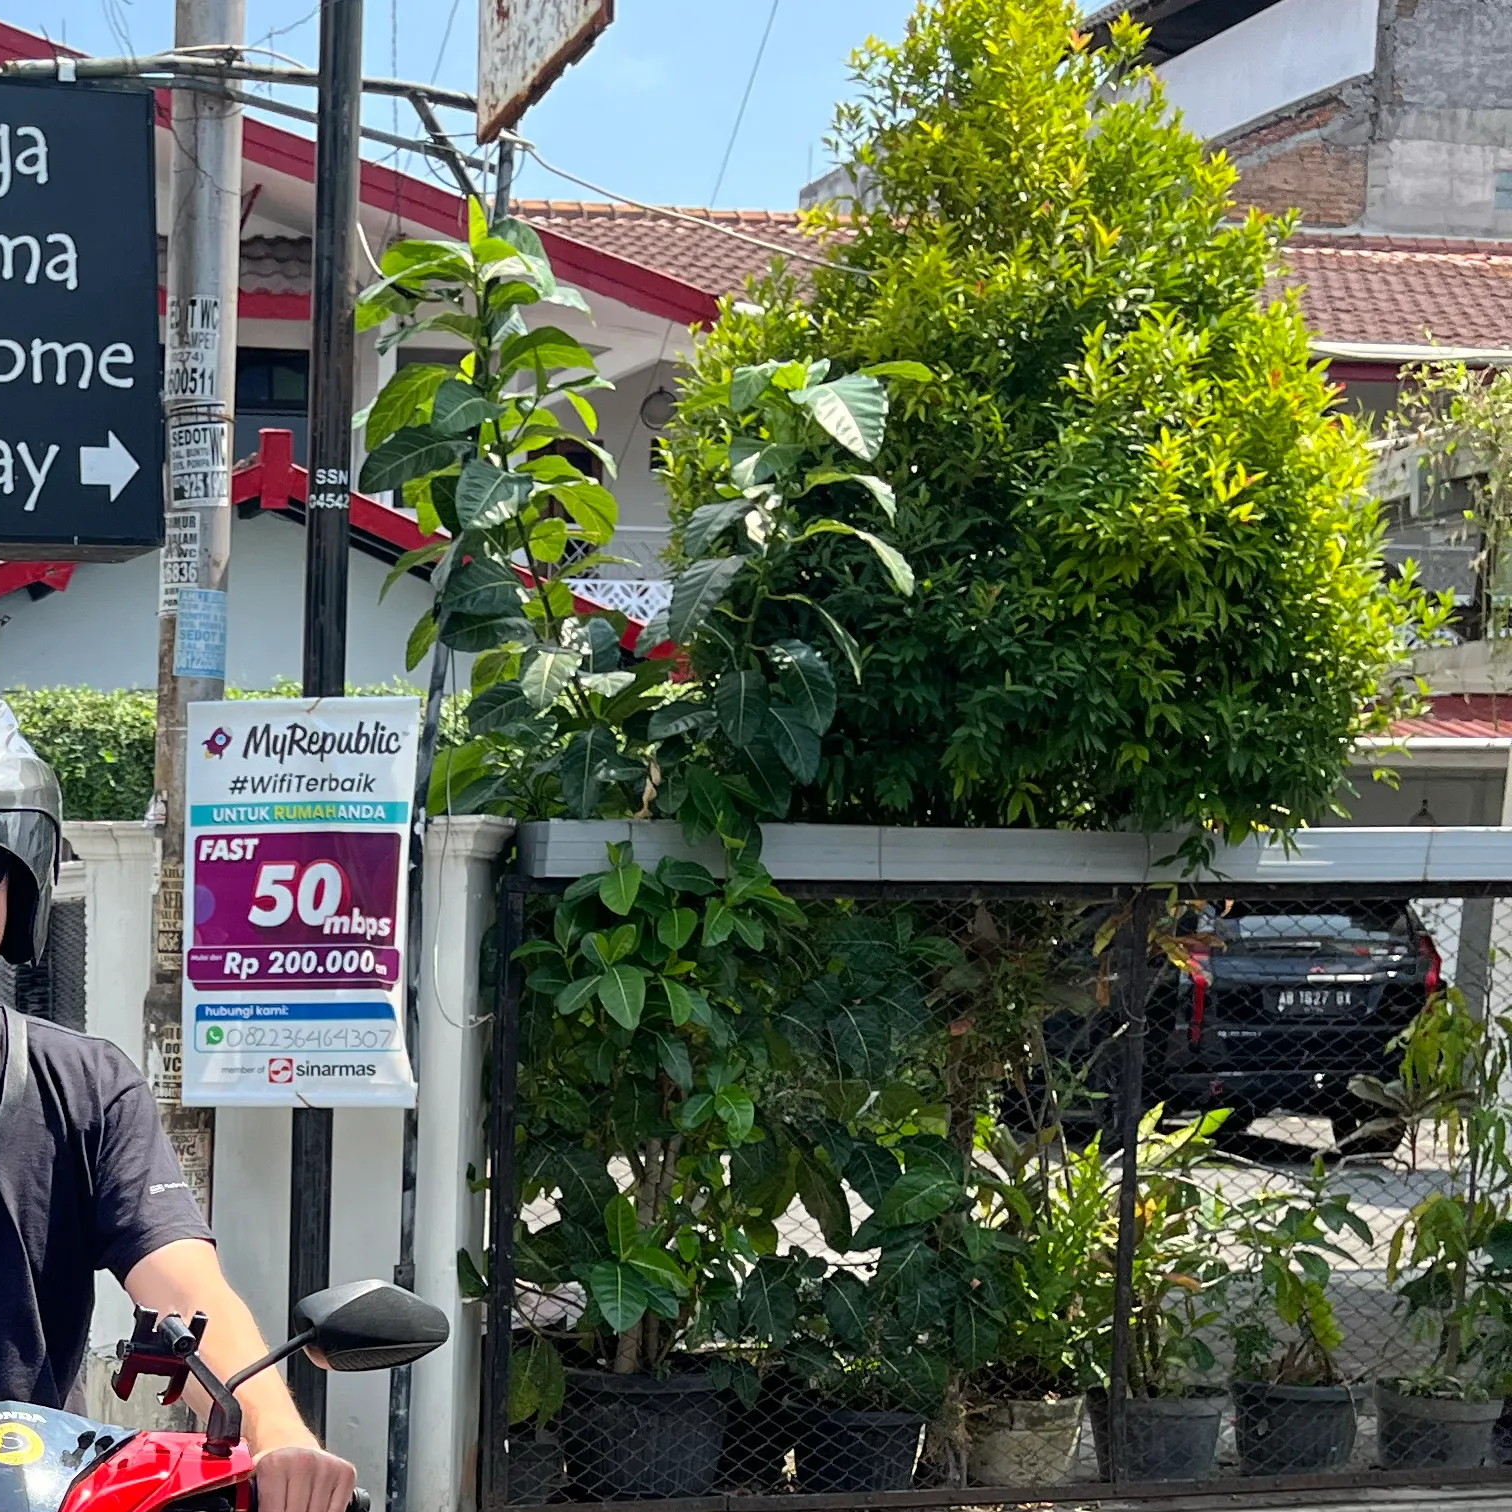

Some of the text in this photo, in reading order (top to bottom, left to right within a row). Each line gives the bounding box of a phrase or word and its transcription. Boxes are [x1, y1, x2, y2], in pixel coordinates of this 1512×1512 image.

[172, 427, 208, 448] SEDOT
[316, 468, 348, 485] SSN
[309, 493, 350, 509] 04542
[180, 630, 217, 641] SEDOT
[243, 721, 402, 764] MyRepublic
[229, 773, 376, 794] #WifiTerbaik
[213, 805, 270, 822] UNTUK
[199, 839, 259, 861] FAST
[248, 862, 392, 940] 50 mbps
[224, 952, 260, 979] Rp
[268, 950, 375, 974] 200.000
[205, 1005, 289, 1018] hubungi kami:
[226, 1027, 392, 1048] 082236464307
[221, 1060, 376, 1077] member of sinarmas
